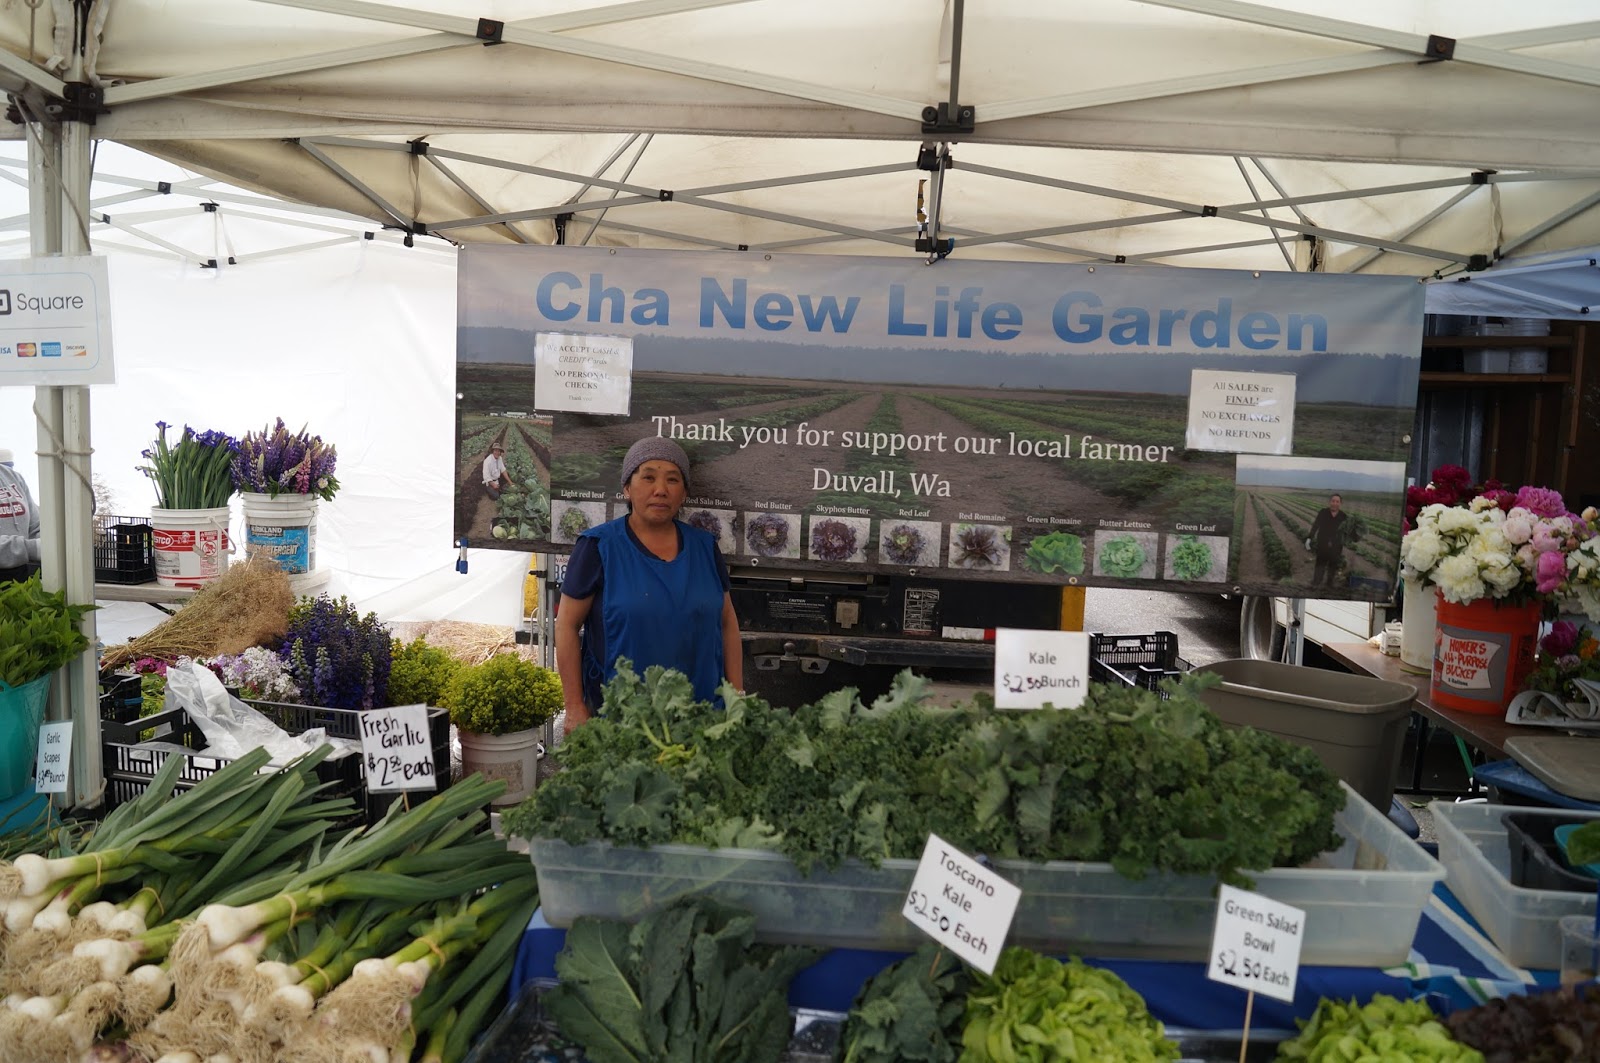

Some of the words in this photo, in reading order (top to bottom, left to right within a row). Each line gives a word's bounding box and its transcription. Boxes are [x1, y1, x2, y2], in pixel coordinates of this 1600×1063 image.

[17, 293, 84, 314] Square
[536, 271, 670, 326] Cha
[699, 277, 861, 334] New
[888, 284, 1023, 340] Life
[1051, 290, 1328, 352] Garden
[546, 344, 557, 352] We
[559, 345, 590, 353] ACCEPT
[592, 347, 613, 355] CASH
[558, 356, 587, 364] CREDIT
[587, 357, 607, 365] Cards
[567, 371, 610, 379] PERSONAL
[564, 381, 598, 389] CHECKS
[1213, 382, 1226, 390] All
[1227, 383, 1259, 392] SALES
[1225, 395, 1259, 405] FINAL!
[1201, 410, 1217, 419] NO
[1218, 411, 1280, 423] EXCHANGES
[651, 415, 735, 442] Thank
[739, 425, 788, 449] you
[795, 422, 834, 447] for
[840, 430, 948, 457] support
[954, 435, 1002, 455] our
[1008, 432, 1071, 458] local
[1079, 435, 1174, 463] farmer
[1208, 428, 1223, 436] NO
[1225, 429, 1271, 439] REFUNDS
[812, 467, 901, 498] Duvall,
[909, 472, 952, 497] Wa
[560, 489, 578, 499] Light
[579, 491, 591, 499] red
[591, 491, 605, 499] leaf
[685, 496, 699, 505] Red
[699, 497, 714, 506] Sala
[714, 498, 732, 507] Bowl
[754, 501, 769, 509] Red
[769, 502, 792, 510] Butter
[816, 504, 846, 514] Skyphos
[847, 506, 870, 515] Butter
[899, 509, 913, 517] Red
[914, 509, 931, 518] Leaf
[958, 512, 973, 521] Red
[974, 512, 1006, 522] Romaine
[1026, 515, 1049, 524] Green
[1049, 516, 1082, 526] Romaine
[251, 525, 283, 533] KIRKLAND
[1099, 519, 1122, 528] Butter
[1123, 520, 1152, 529] Lettuce
[1175, 522, 1198, 531] Green
[1199, 523, 1216, 532] Leaf
[1028, 652, 1057, 665] Kale
[1445, 665, 1477, 680] BUCKET
[361, 711, 399, 738] Fresh
[46, 732, 61, 744] Garlic
[381, 723, 425, 749] Garlic
[44, 752, 61, 764] Scapes
[403, 756, 434, 781] each
[940, 850, 995, 897] Toscano
[942, 883, 973, 912] Kale
[1224, 899, 1264, 924] Green
[1266, 912, 1298, 935] Salad
[954, 923, 988, 955] Each
[1243, 932, 1276, 954] Bowl
[1263, 966, 1290, 987] Each
